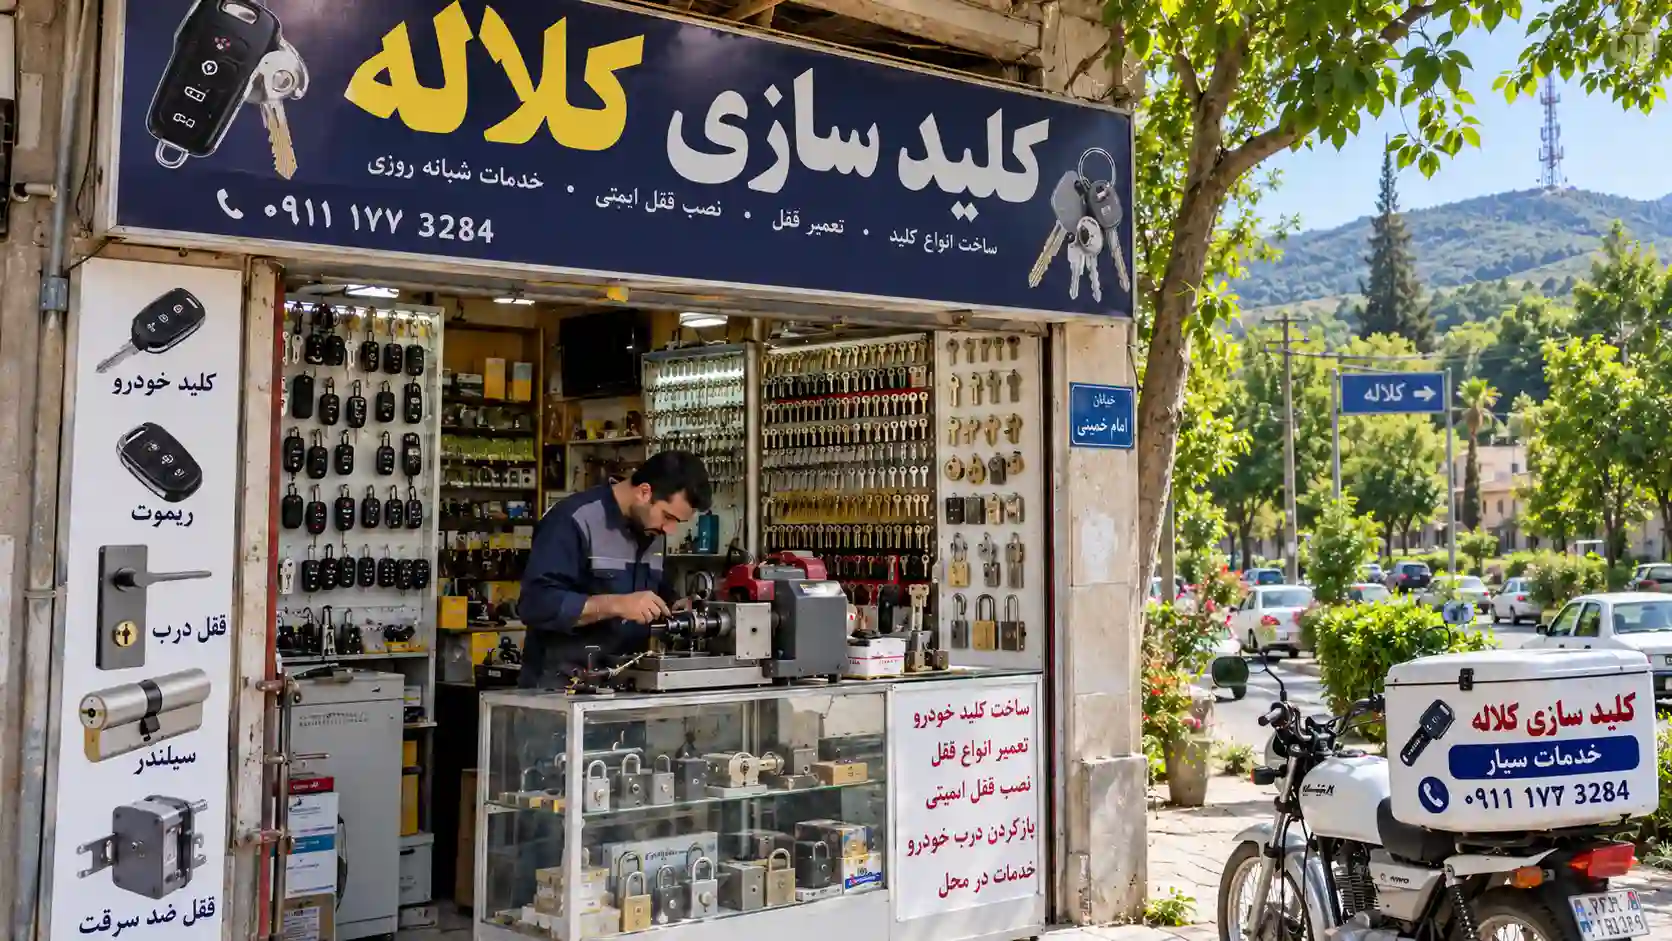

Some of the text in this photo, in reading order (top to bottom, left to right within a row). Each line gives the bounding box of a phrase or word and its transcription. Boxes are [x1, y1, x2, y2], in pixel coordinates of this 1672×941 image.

[343, 0, 1050, 222] کلید سازی کلاله
[367, 155, 414, 179] روزی
[422, 158, 472, 184] شبانه
[479, 167, 544, 189] خدمات
[682, 200, 722, 219] نصب
[418, 212, 494, 244] 3284
[805, 219, 845, 236] تعمیر
[889, 227, 918, 247] کلید
[923, 231, 954, 254] انواع
[958, 236, 998, 255] ساخت
[112, 372, 217, 396] کلید خودرو
[1363, 382, 1407, 402] کلاله
[1077, 416, 1128, 441] امام خمینی
[131, 504, 194, 527] ریموت
[152, 622, 192, 644] درب
[913, 698, 1030, 729] ساخت کلید خودرو
[1471, 692, 1637, 737] کلید سازی کلاله
[133, 745, 196, 775] سیلندر
[961, 739, 992, 767] انواع
[995, 737, 1029, 762] تعمیر
[1486, 744, 1602, 776] خدمات سیار
[1000, 775, 1031, 800] نصب
[1574, 779, 1630, 805] 3284
[907, 827, 950, 857] خودرو
[954, 827, 983, 849] درب
[938, 860, 1036, 899] خدمات در محل
[79, 908, 140, 937] سرقت
[146, 903, 177, 926] ضد
